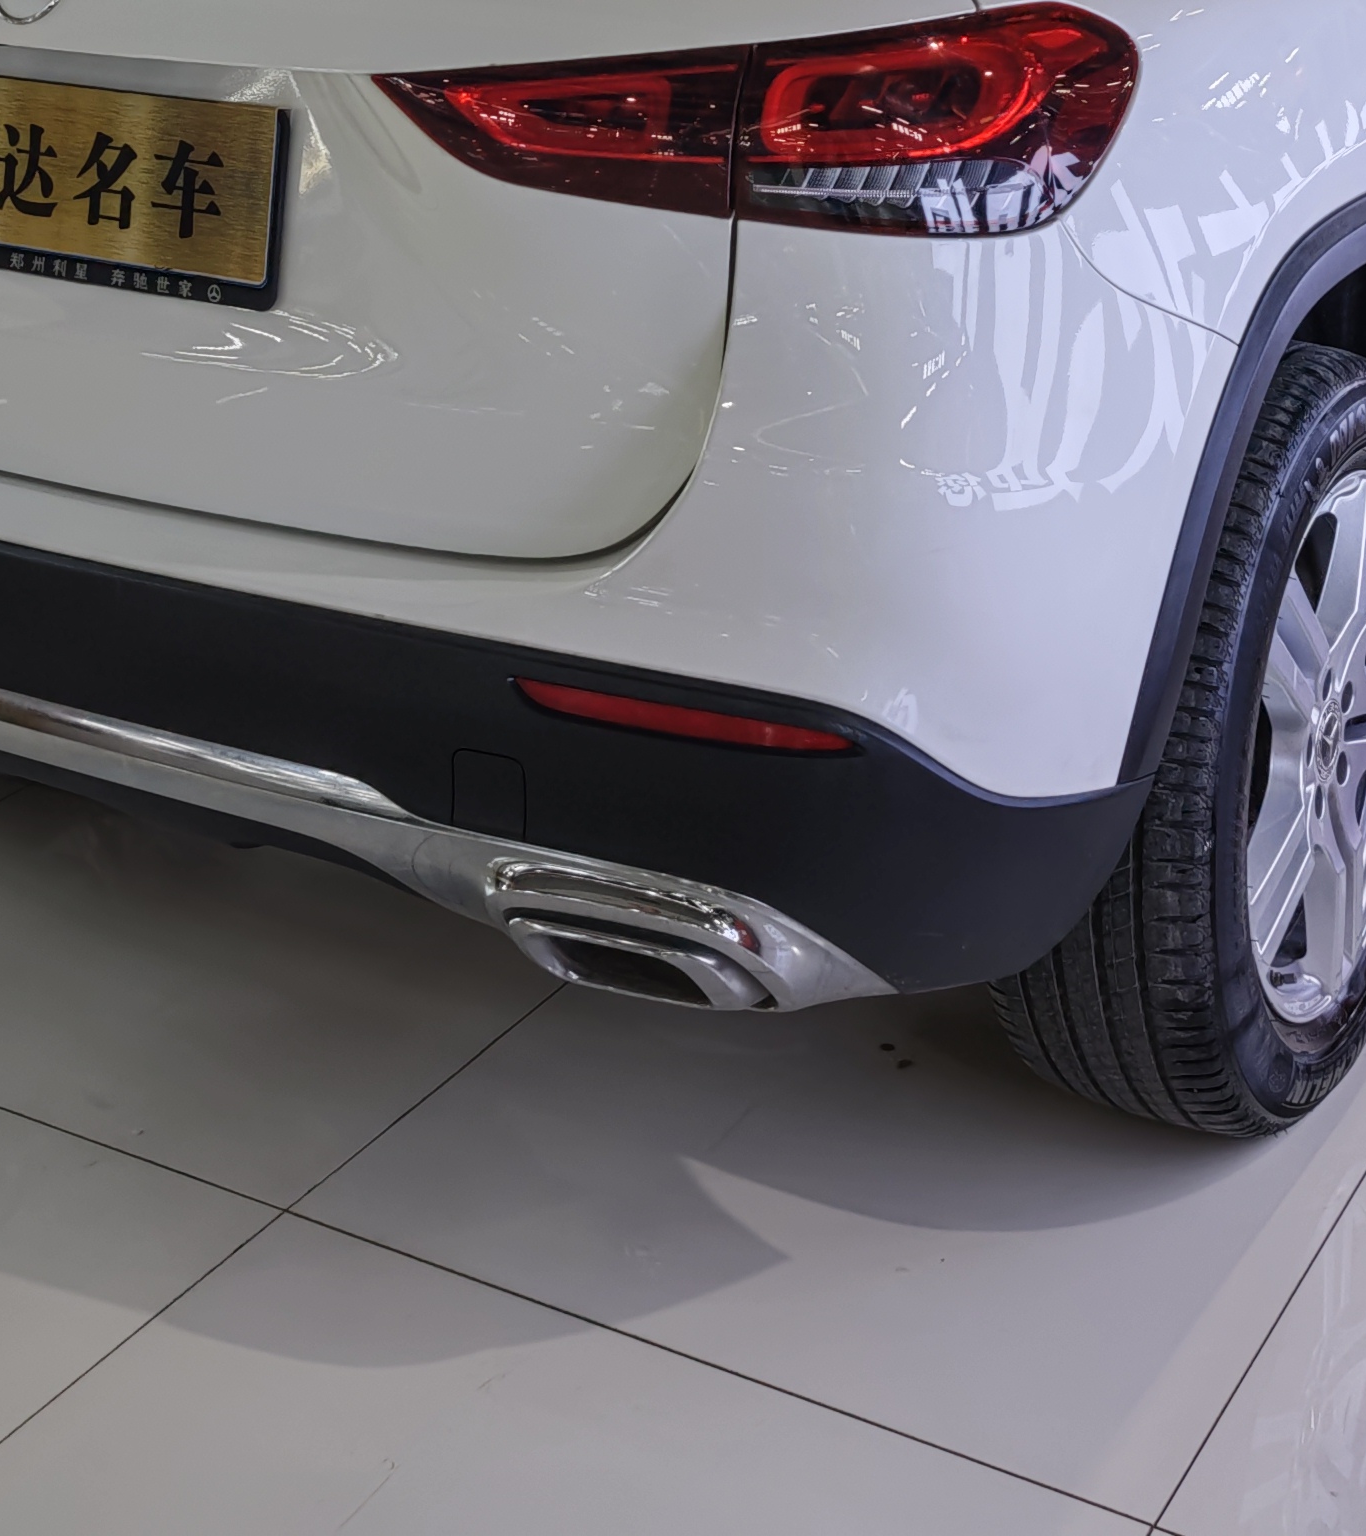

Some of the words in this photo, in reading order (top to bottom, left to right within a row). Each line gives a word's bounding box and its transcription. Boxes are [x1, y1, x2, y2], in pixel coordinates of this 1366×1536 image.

[10, 251, 89, 281] 郑州利星
[110, 268, 193, 298] 奔驰世家
